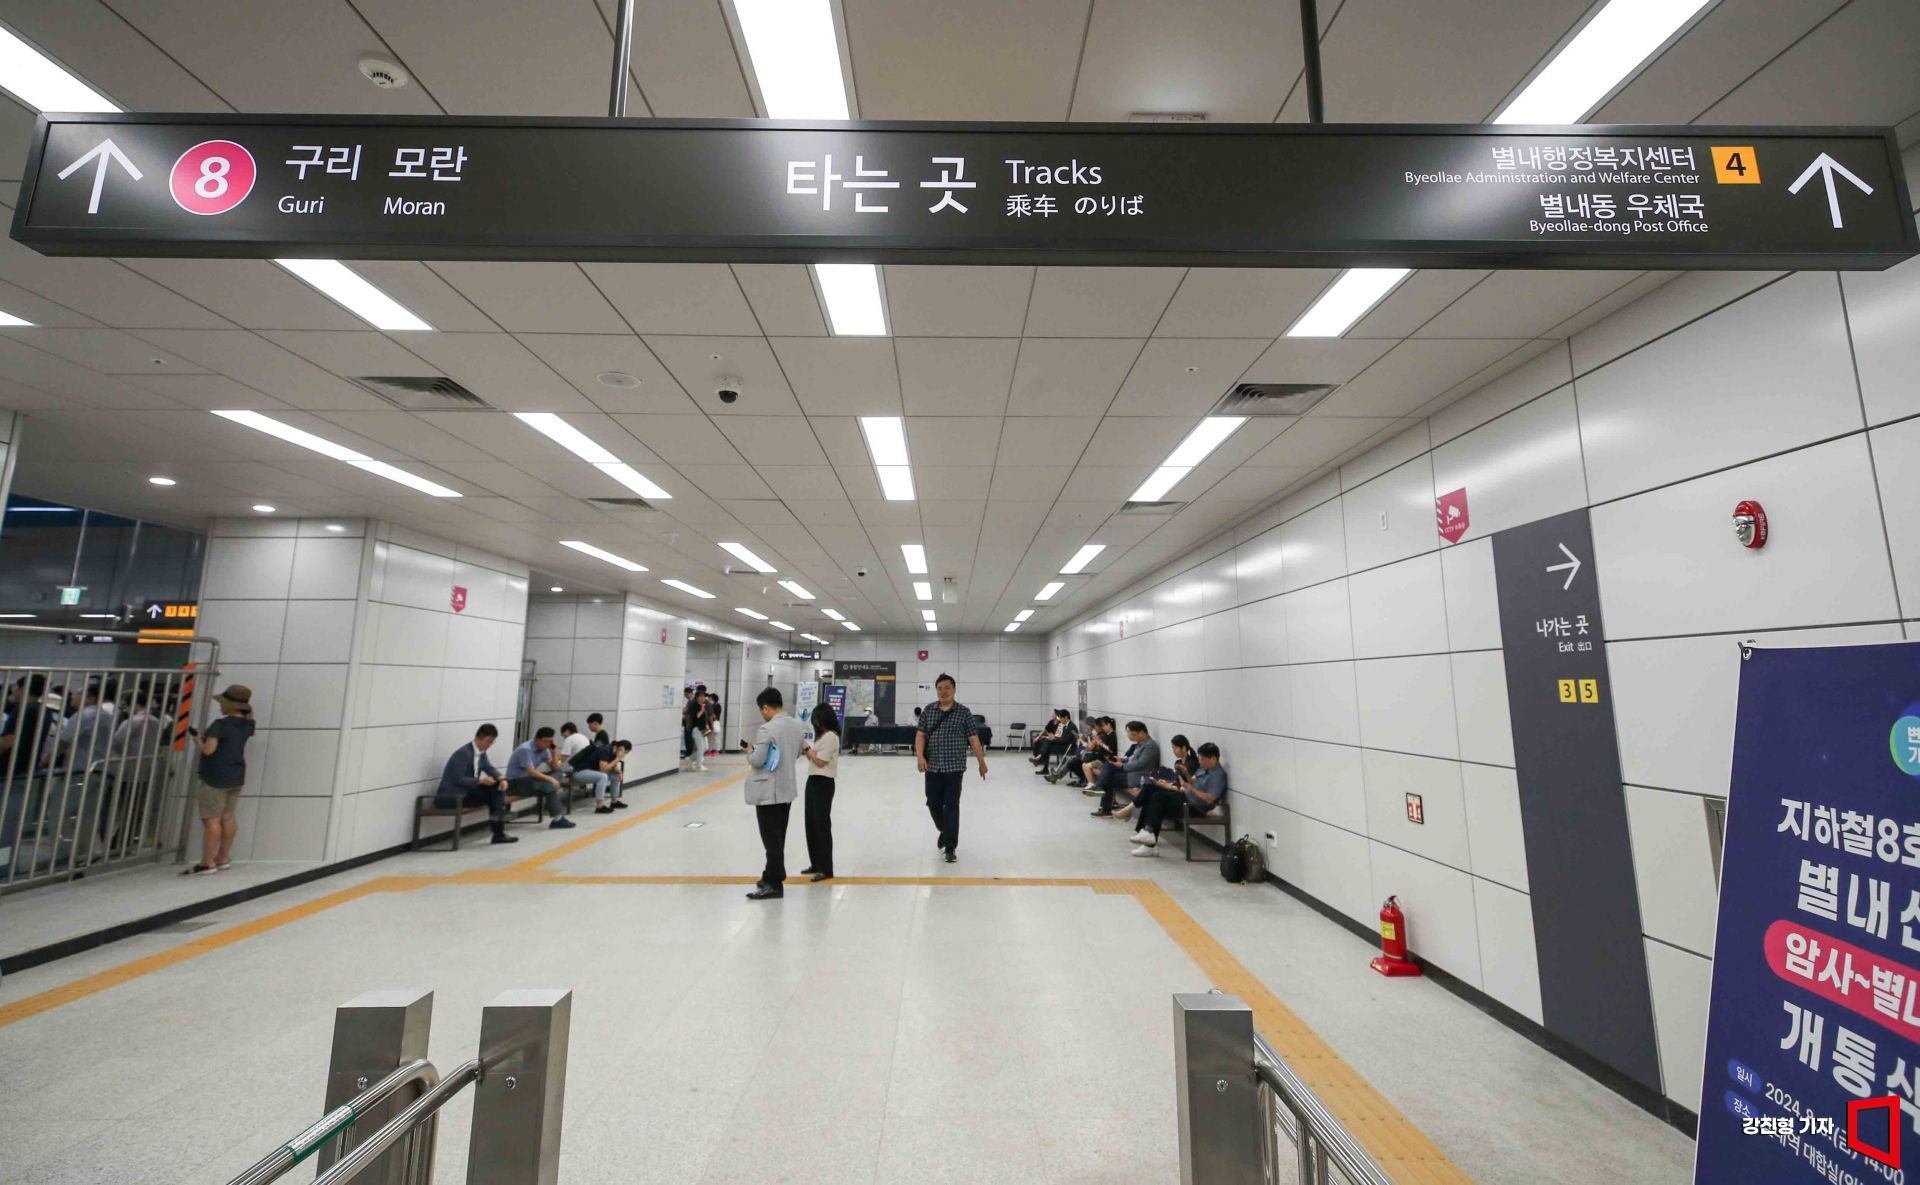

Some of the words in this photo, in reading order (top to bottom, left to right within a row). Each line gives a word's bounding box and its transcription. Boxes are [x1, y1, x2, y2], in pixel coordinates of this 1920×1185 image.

[285, 145, 362, 180] 구리
[388, 146, 468, 181] 모란
[1491, 146, 1696, 171] 별내행정복지센터
[1725, 152, 1747, 178] 4
[195, 157, 229, 198] 8
[1005, 159, 1103, 185] Tracks
[1405, 171, 1462, 186] Byeollae
[1466, 170, 1567, 185] Administration
[1571, 171, 1595, 184] and
[1598, 171, 1651, 184] Welfare
[1654, 171, 1700, 184] Center
[786, 154, 900, 214] 타는
[919, 156, 977, 214] 곳
[277, 195, 325, 215] Guri
[383, 196, 446, 216] Moran
[1074, 195, 1144, 216] のりば
[1539, 194, 1617, 219] 별내동
[1626, 194, 1705, 219] 우체국
[1530, 219, 1631, 236] Byeollae-dong
[1634, 220, 1664, 234] Post
[1667, 220, 1708, 234] Office
[1536, 616, 1572, 637] 나가는
[1575, 615, 1590, 634] 곳
[1559, 641, 1575, 652] Exit
[1578, 641, 1592, 651] 出口
[1563, 684, 1572, 698] 3
[1584, 683, 1593, 698] 5
[1736, 1066, 1753, 1087] 일시
